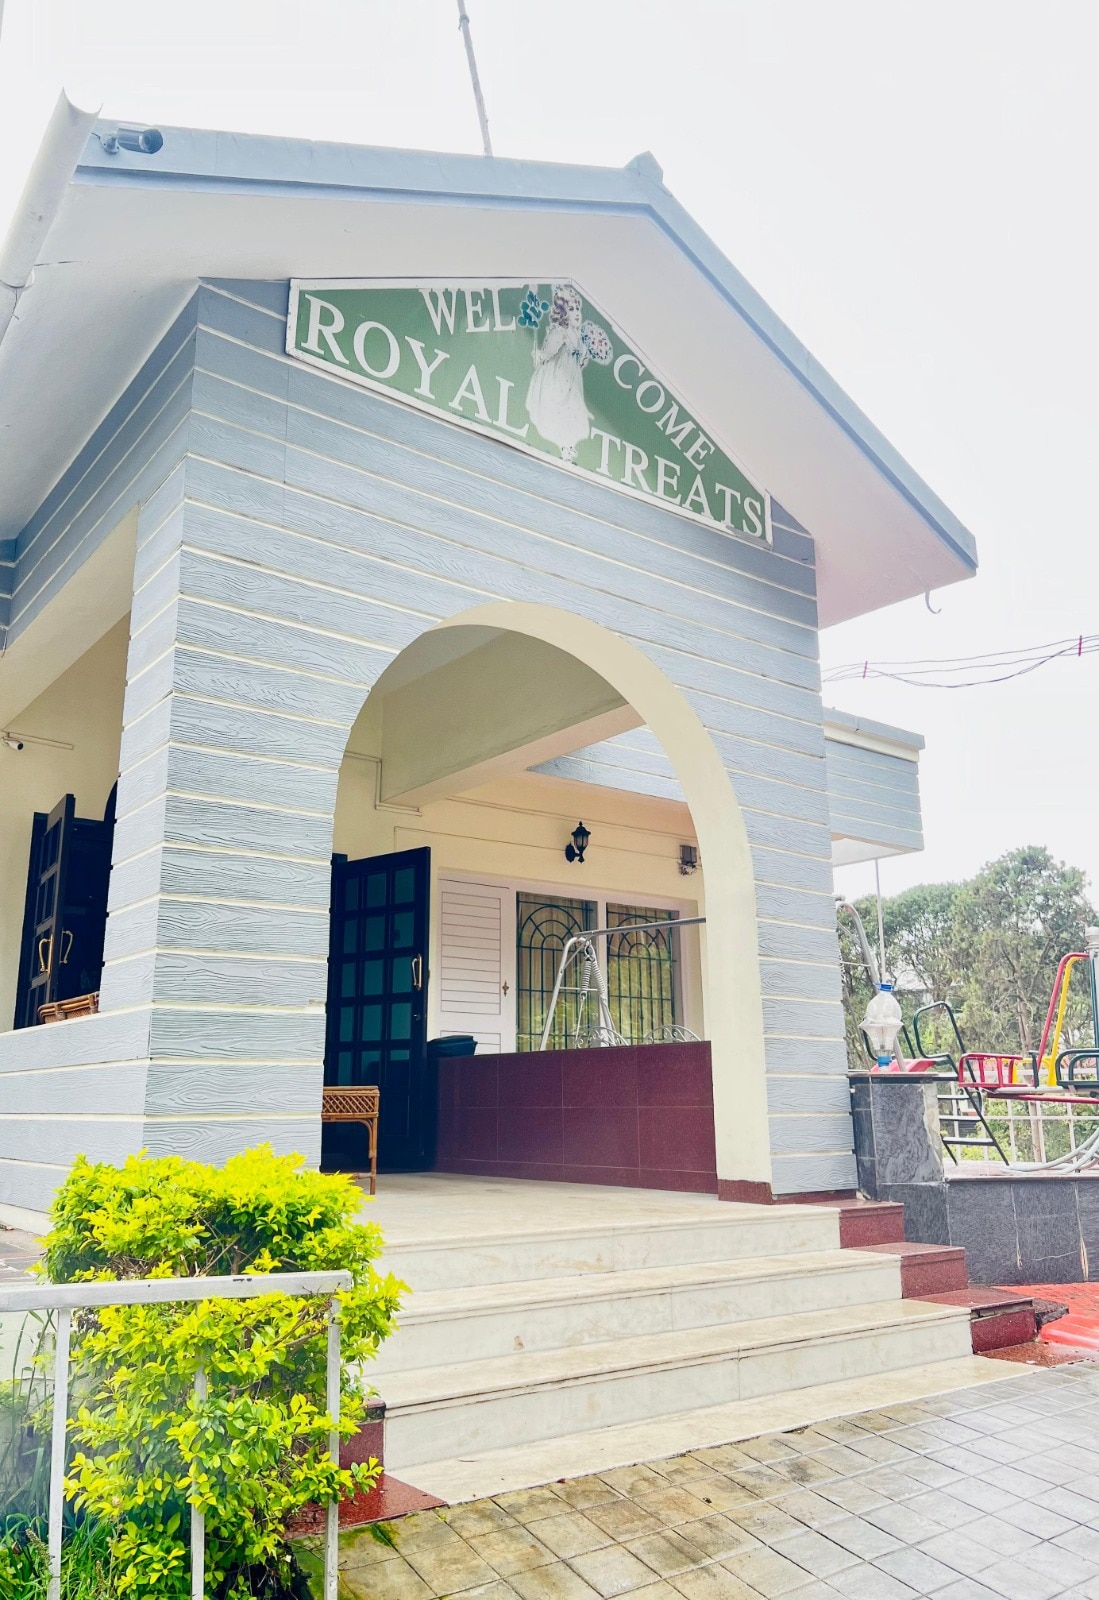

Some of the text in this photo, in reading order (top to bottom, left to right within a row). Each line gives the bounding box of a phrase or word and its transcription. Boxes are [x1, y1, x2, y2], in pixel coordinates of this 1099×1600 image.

[300, 293, 763, 538] ROYAL TREATS
[418, 287, 716, 471] WEL COME
